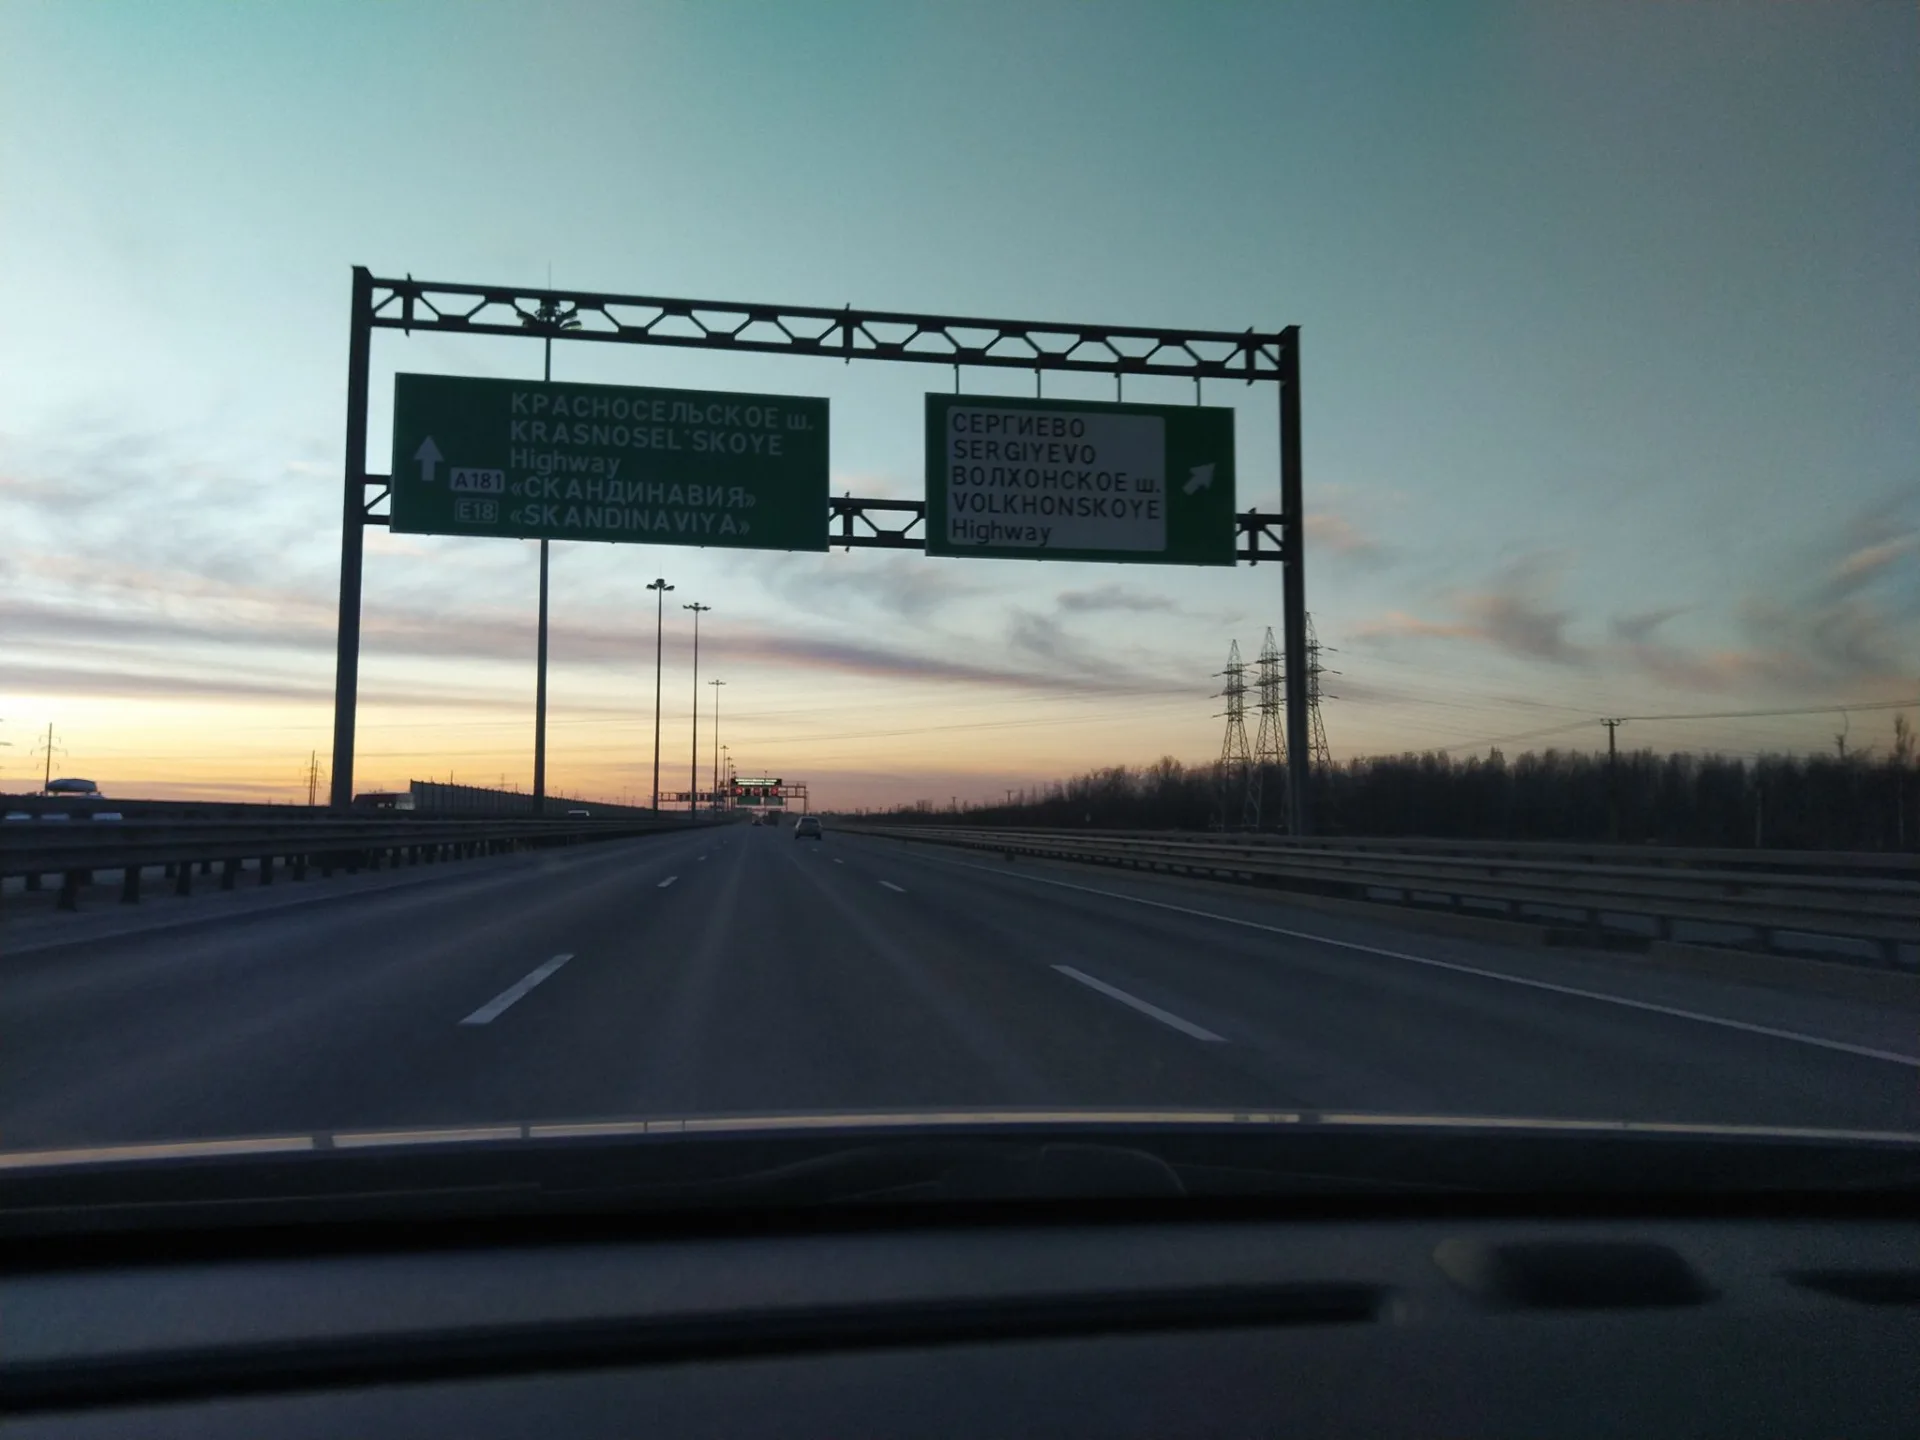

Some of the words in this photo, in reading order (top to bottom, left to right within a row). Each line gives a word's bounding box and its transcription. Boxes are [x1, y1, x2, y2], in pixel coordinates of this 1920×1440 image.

[511, 391, 779, 430] КРАСНОСЕЛЬСКОЕ
[952, 413, 1085, 438] СЕРГИЕВО
[510, 448, 621, 481] Highway
[953, 440, 1096, 465] SERGIYEVO
[510, 476, 757, 509] «СКАНДИНАВИЯ»
[952, 466, 1127, 492] ВОЛХОНСКОЕ
[458, 501, 494, 521] E18
[952, 492, 1161, 520] VOLKHONSKOYE
[509, 504, 750, 536] «SKANDINAVIYA»
[952, 520, 1052, 547] Highway
